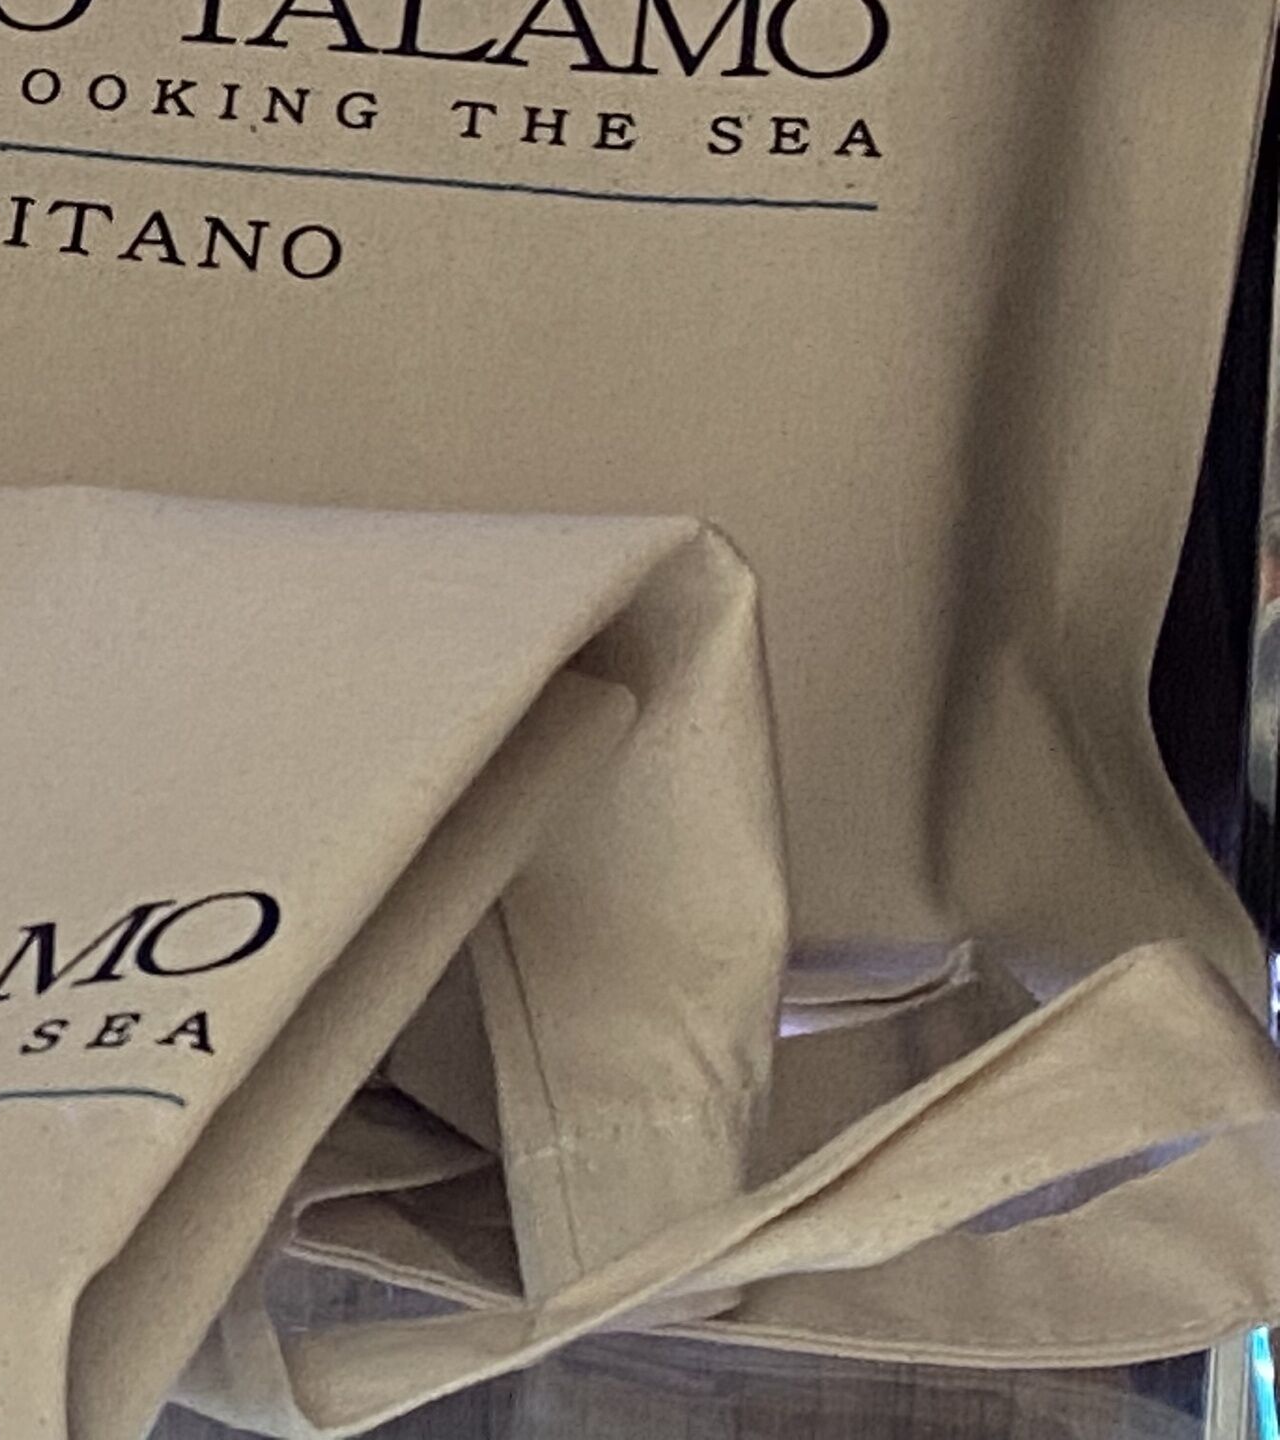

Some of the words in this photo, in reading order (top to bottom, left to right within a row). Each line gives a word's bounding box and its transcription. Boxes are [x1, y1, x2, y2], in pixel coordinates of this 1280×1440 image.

[451, 99, 637, 150] THE
[707, 116, 883, 158] SEA
[20, 1010, 216, 1056] SEA
